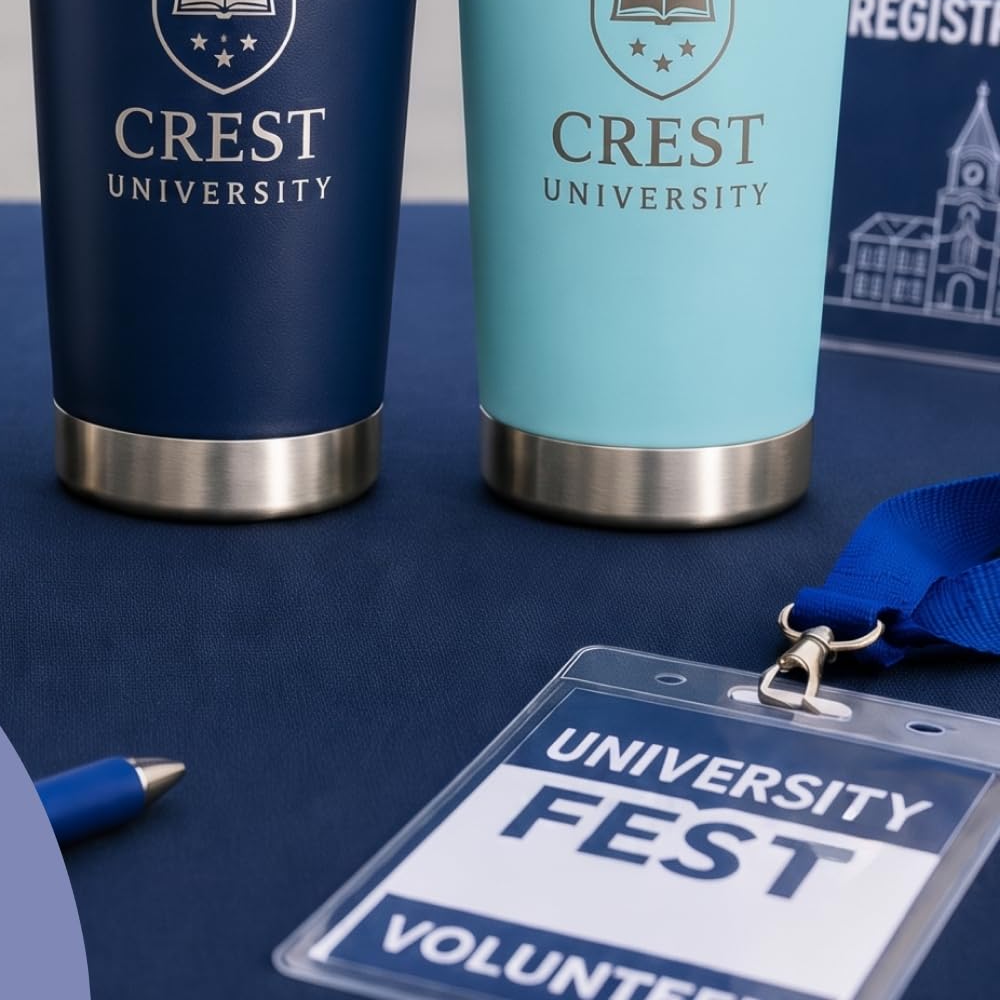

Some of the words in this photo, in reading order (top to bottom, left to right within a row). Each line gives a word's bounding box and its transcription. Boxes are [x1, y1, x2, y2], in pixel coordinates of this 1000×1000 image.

[114, 107, 326, 162] CREST
[552, 111, 765, 167] CREST
[107, 173, 332, 205] UNIVERSITY
[543, 177, 769, 210] UNIVERSITY
[546, 726, 934, 833] UNIVERSITY
[498, 785, 856, 900] FEST
